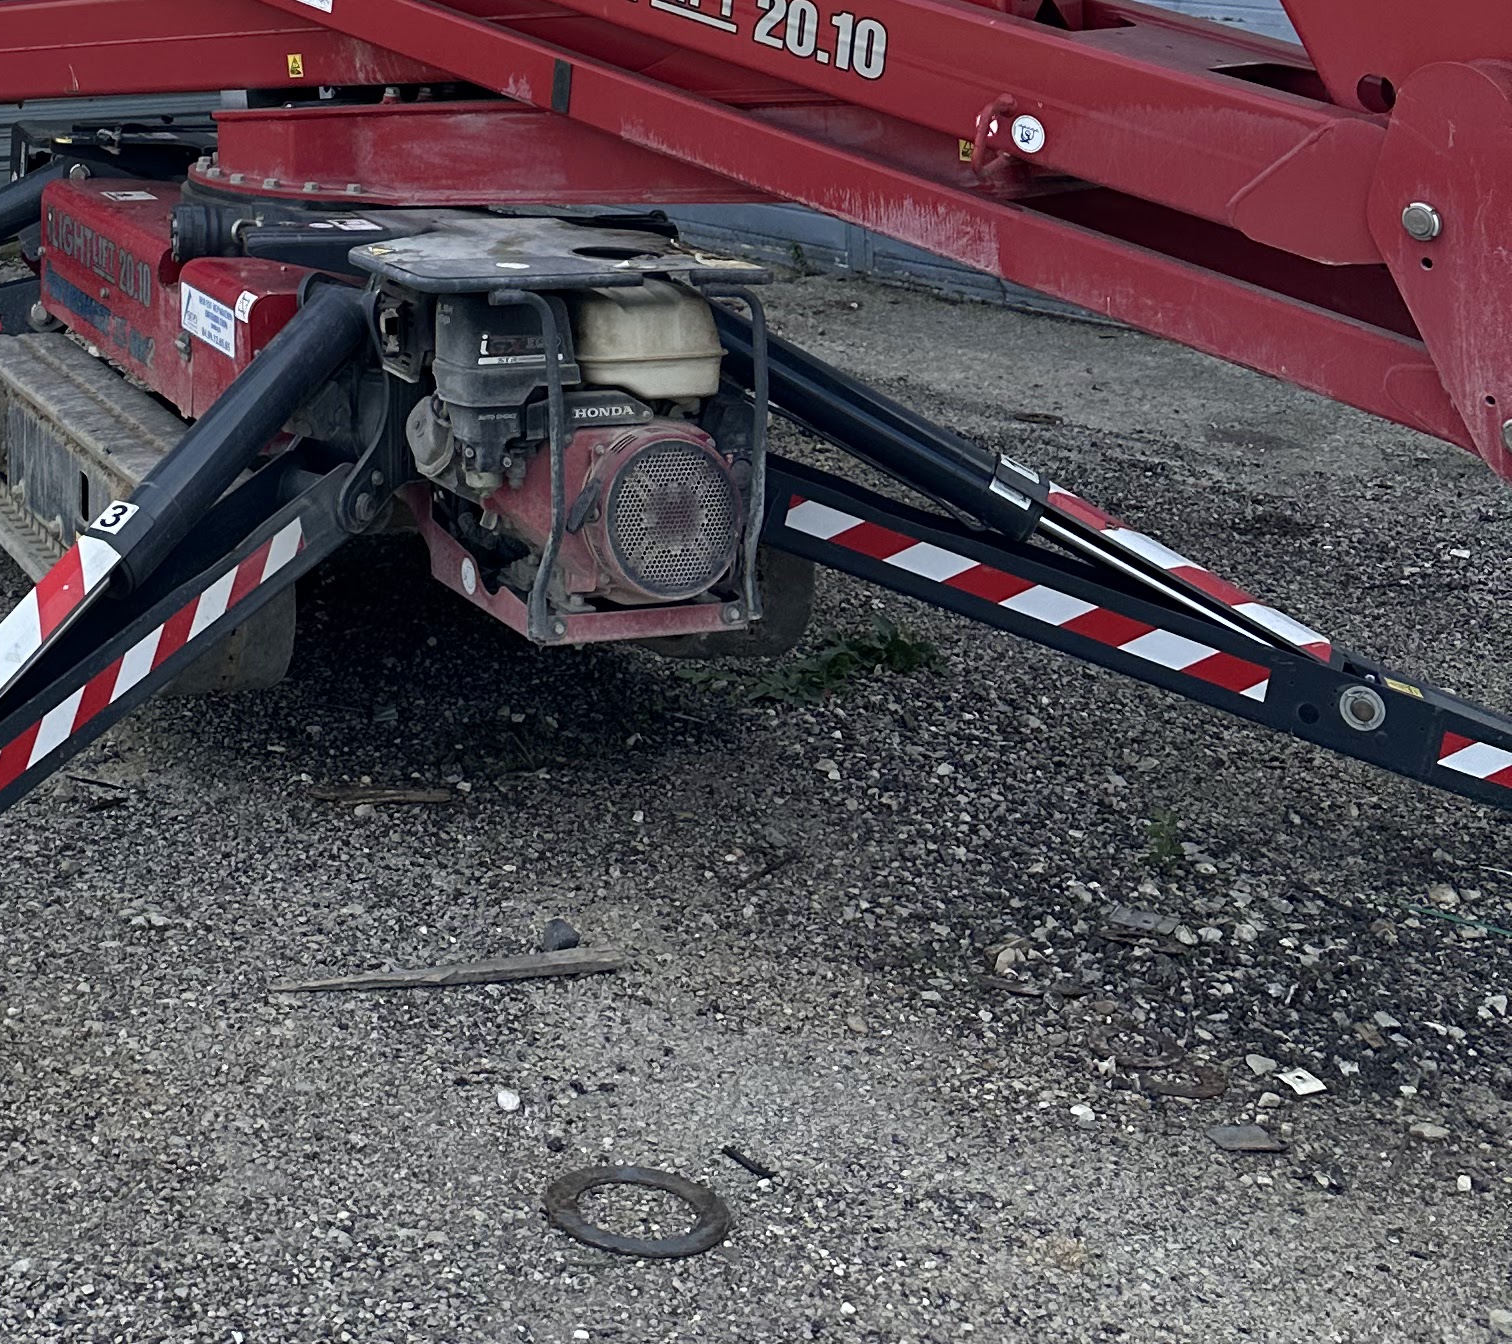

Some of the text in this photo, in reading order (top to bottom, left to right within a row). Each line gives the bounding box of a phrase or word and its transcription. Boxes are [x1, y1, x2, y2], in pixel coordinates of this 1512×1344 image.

[118, 248, 151, 308] 20.10
[574, 405, 635, 419] HONDA
[99, 504, 128, 528] 3
